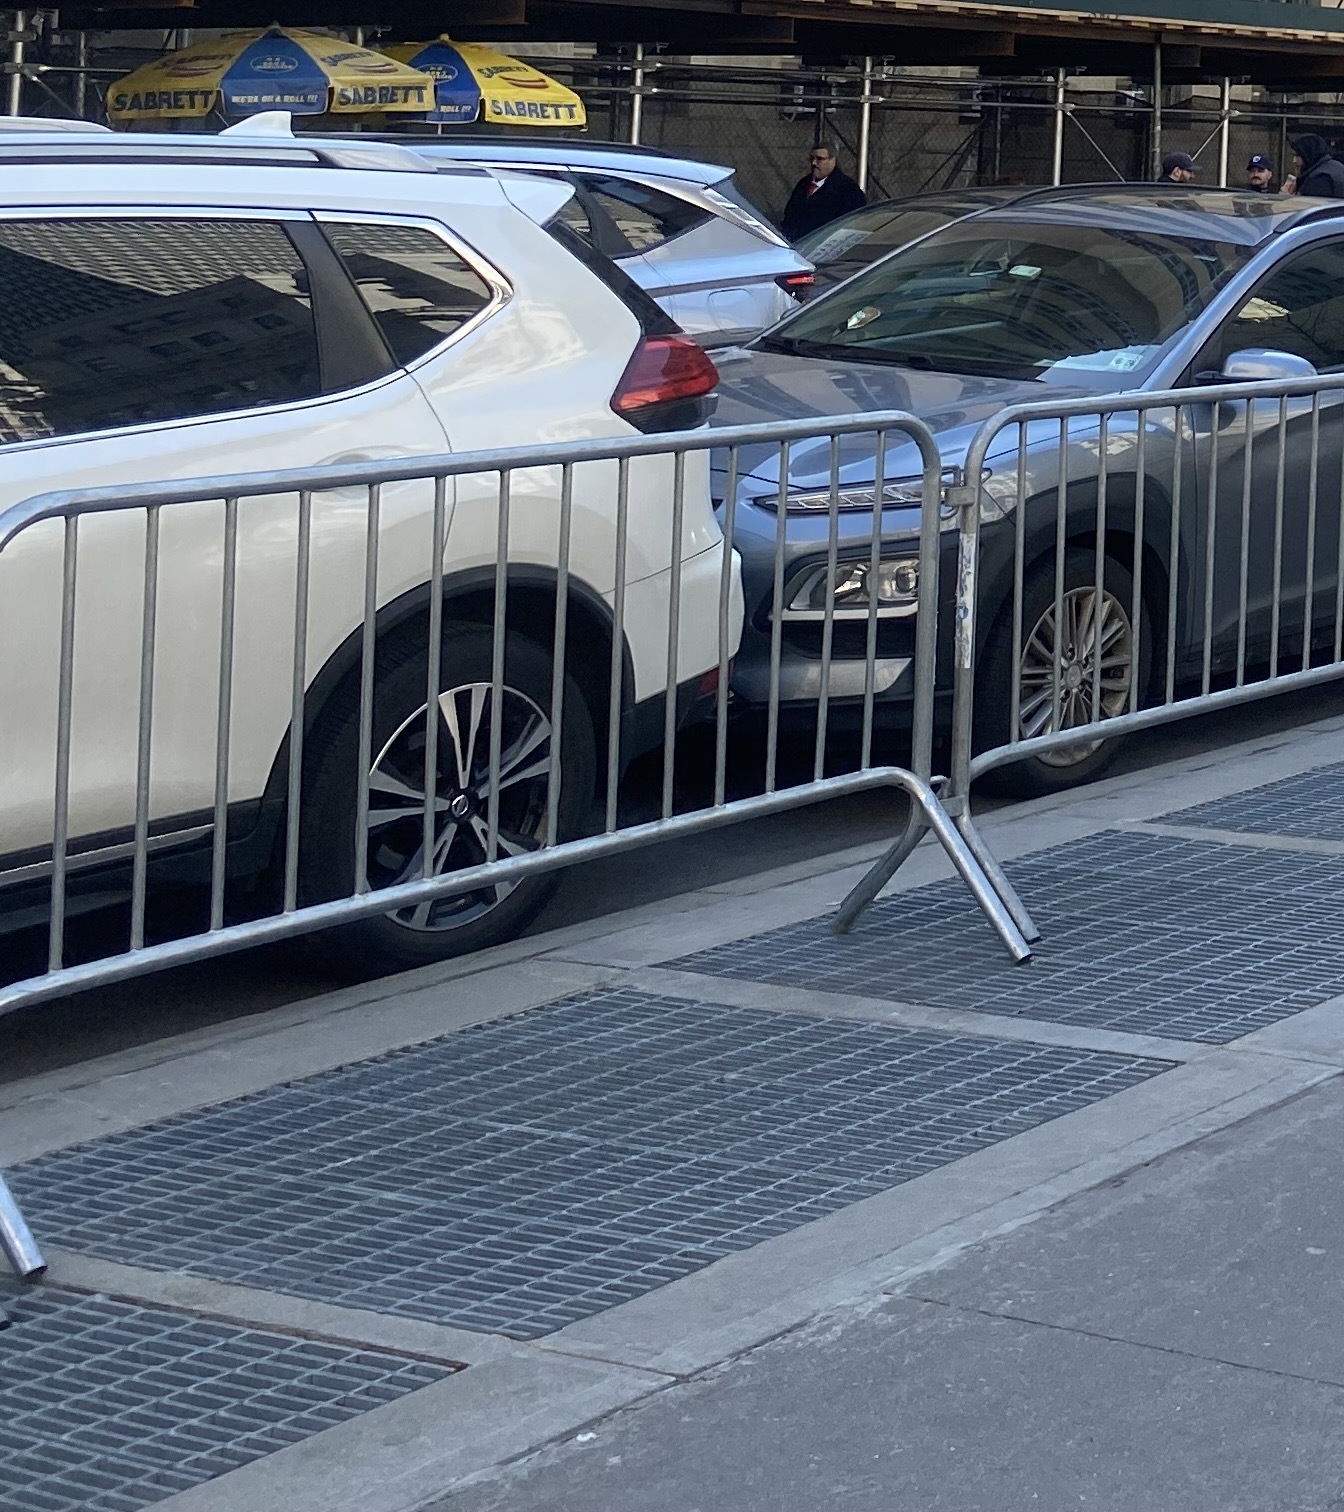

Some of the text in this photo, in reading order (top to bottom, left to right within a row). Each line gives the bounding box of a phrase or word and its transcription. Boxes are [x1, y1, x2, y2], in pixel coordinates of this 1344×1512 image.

[113, 90, 214, 112] SABRETT
[283, 95, 305, 103] ROLL
[337, 85, 428, 105] SABRETT
[490, 99, 577, 120] SABRETT
